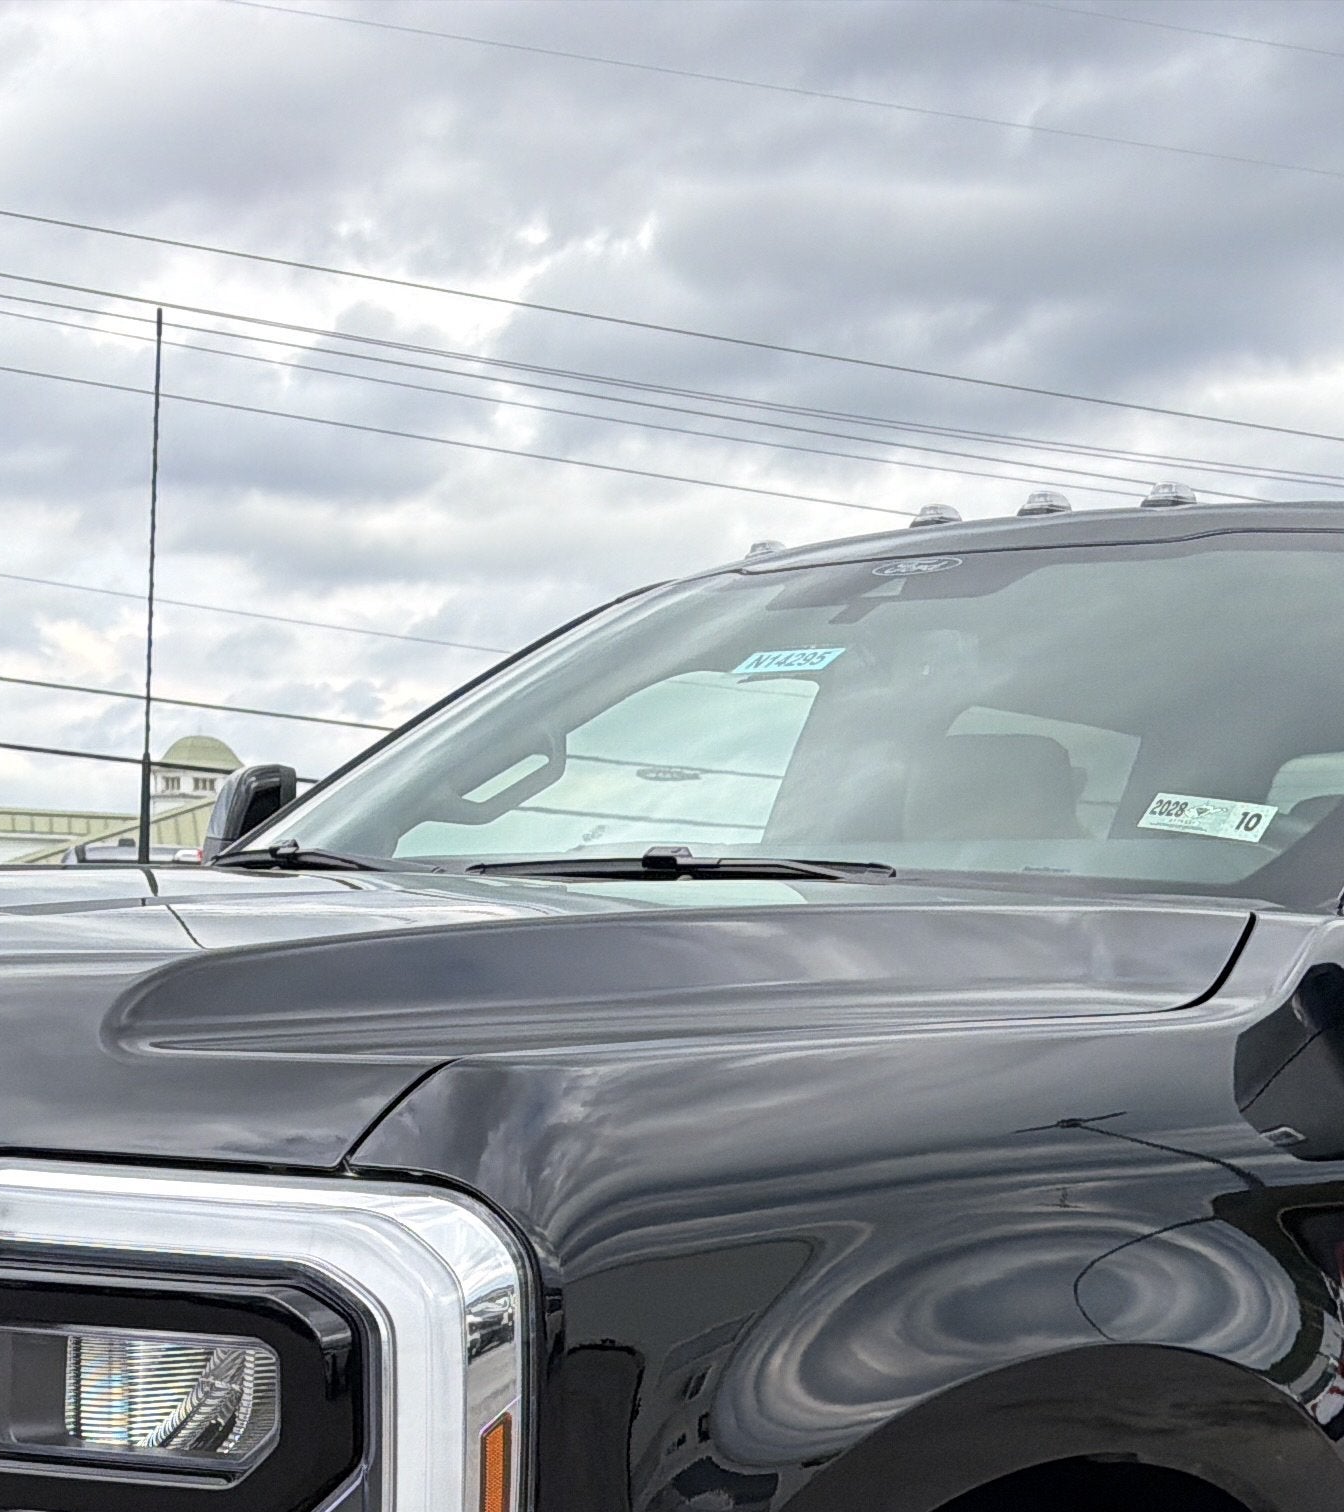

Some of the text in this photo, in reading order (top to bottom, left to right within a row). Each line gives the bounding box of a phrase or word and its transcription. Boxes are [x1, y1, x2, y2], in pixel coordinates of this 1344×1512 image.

[745, 651, 831, 669] N14295
[1149, 799, 1263, 832] 2028 10
